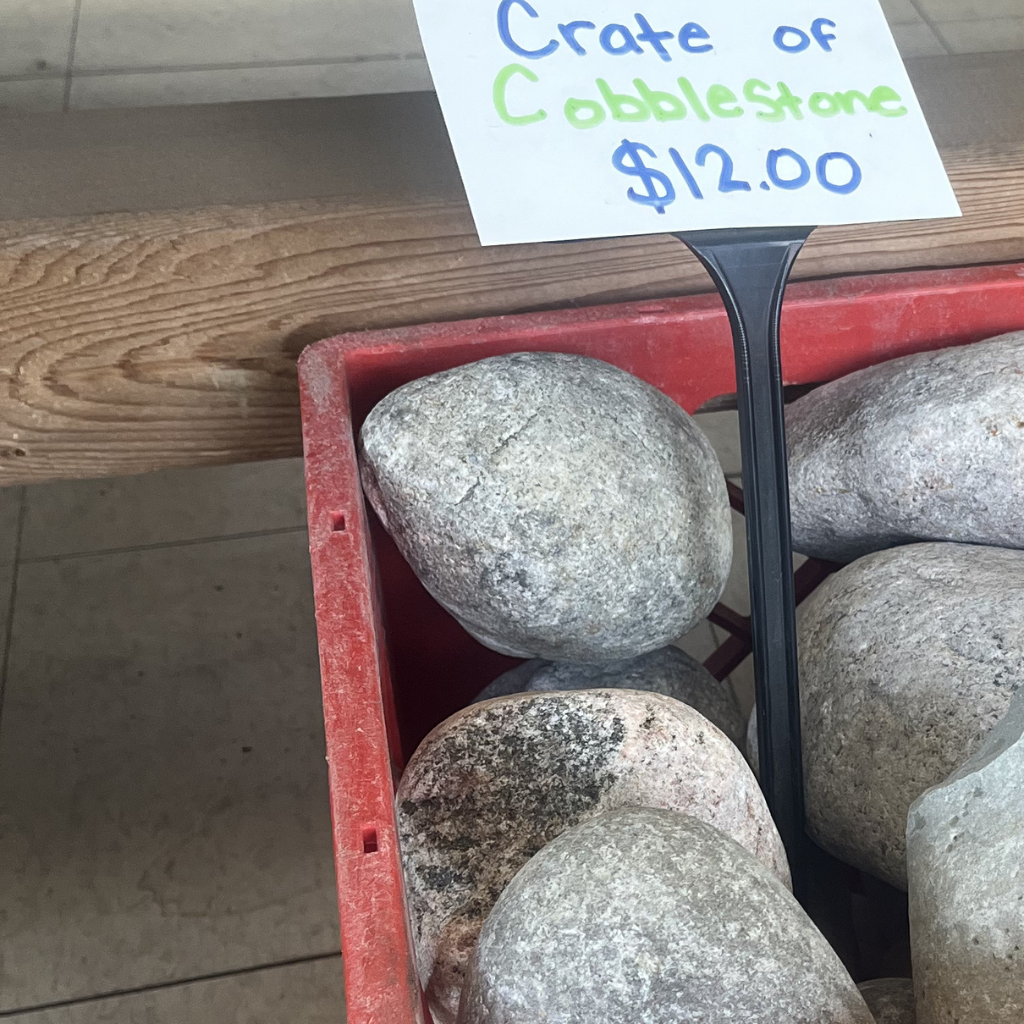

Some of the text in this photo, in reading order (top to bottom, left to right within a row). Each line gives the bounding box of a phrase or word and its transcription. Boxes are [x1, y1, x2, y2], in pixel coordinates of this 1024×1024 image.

[497, 0, 837, 62] Crate of
[611, 138, 862, 214] $12.00
